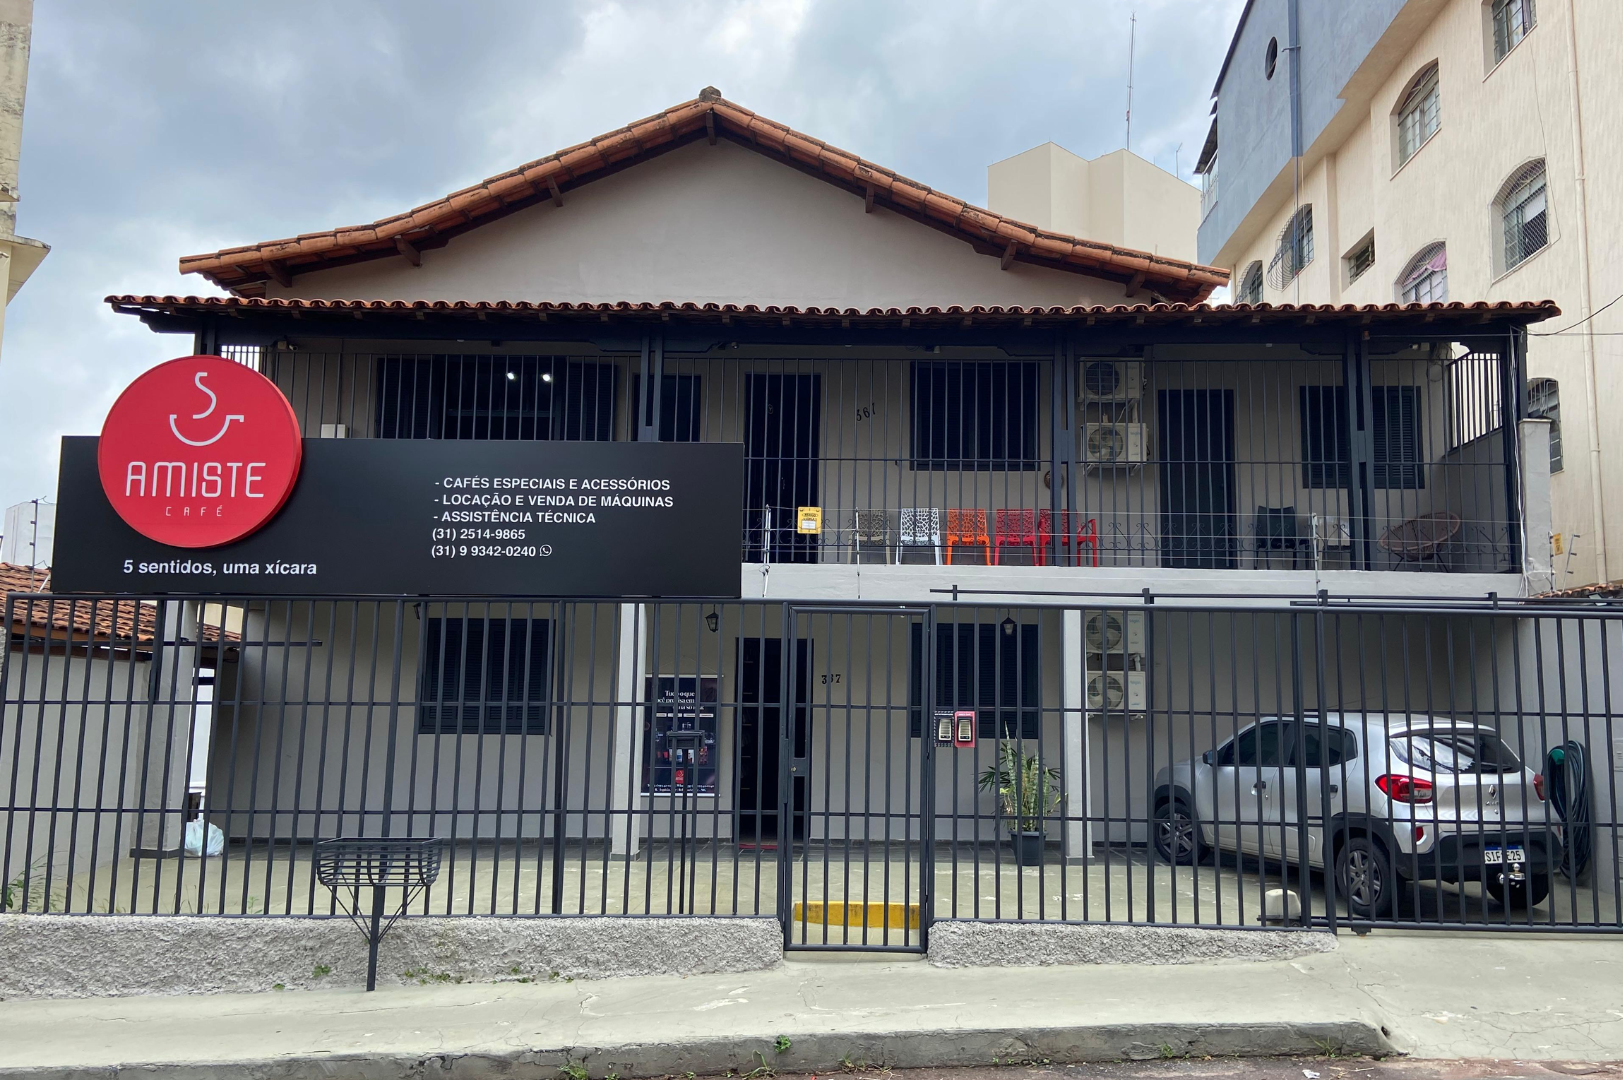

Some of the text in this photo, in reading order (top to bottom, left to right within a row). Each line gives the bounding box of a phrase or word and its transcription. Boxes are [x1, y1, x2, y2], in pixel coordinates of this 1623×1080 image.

[125, 461, 266, 498] AMISTE
[443, 474, 490, 489] CAFÉS
[493, 477, 566, 490] ESPECIAIS
[569, 478, 578, 490] E
[580, 476, 671, 491] ACESSÓRIOS
[442, 492, 512, 508] LOCAÇÃO
[515, 494, 525, 506] E
[527, 494, 575, 507] VENDA
[578, 495, 597, 507] DE
[600, 493, 674, 508] MÁQUINAS
[165, 504, 223, 517] CAFÉ
[441, 508, 533, 523] ASSISTÊNCIA
[535, 509, 596, 524] TÉCNICA
[432, 527, 526, 542] (31) 2514-9865
[431, 544, 537, 559] (31) 9 9342-0240
[123, 559, 317, 577] 5 sentidos, uma xícara
[1485, 850, 1522, 862] SIFE25
